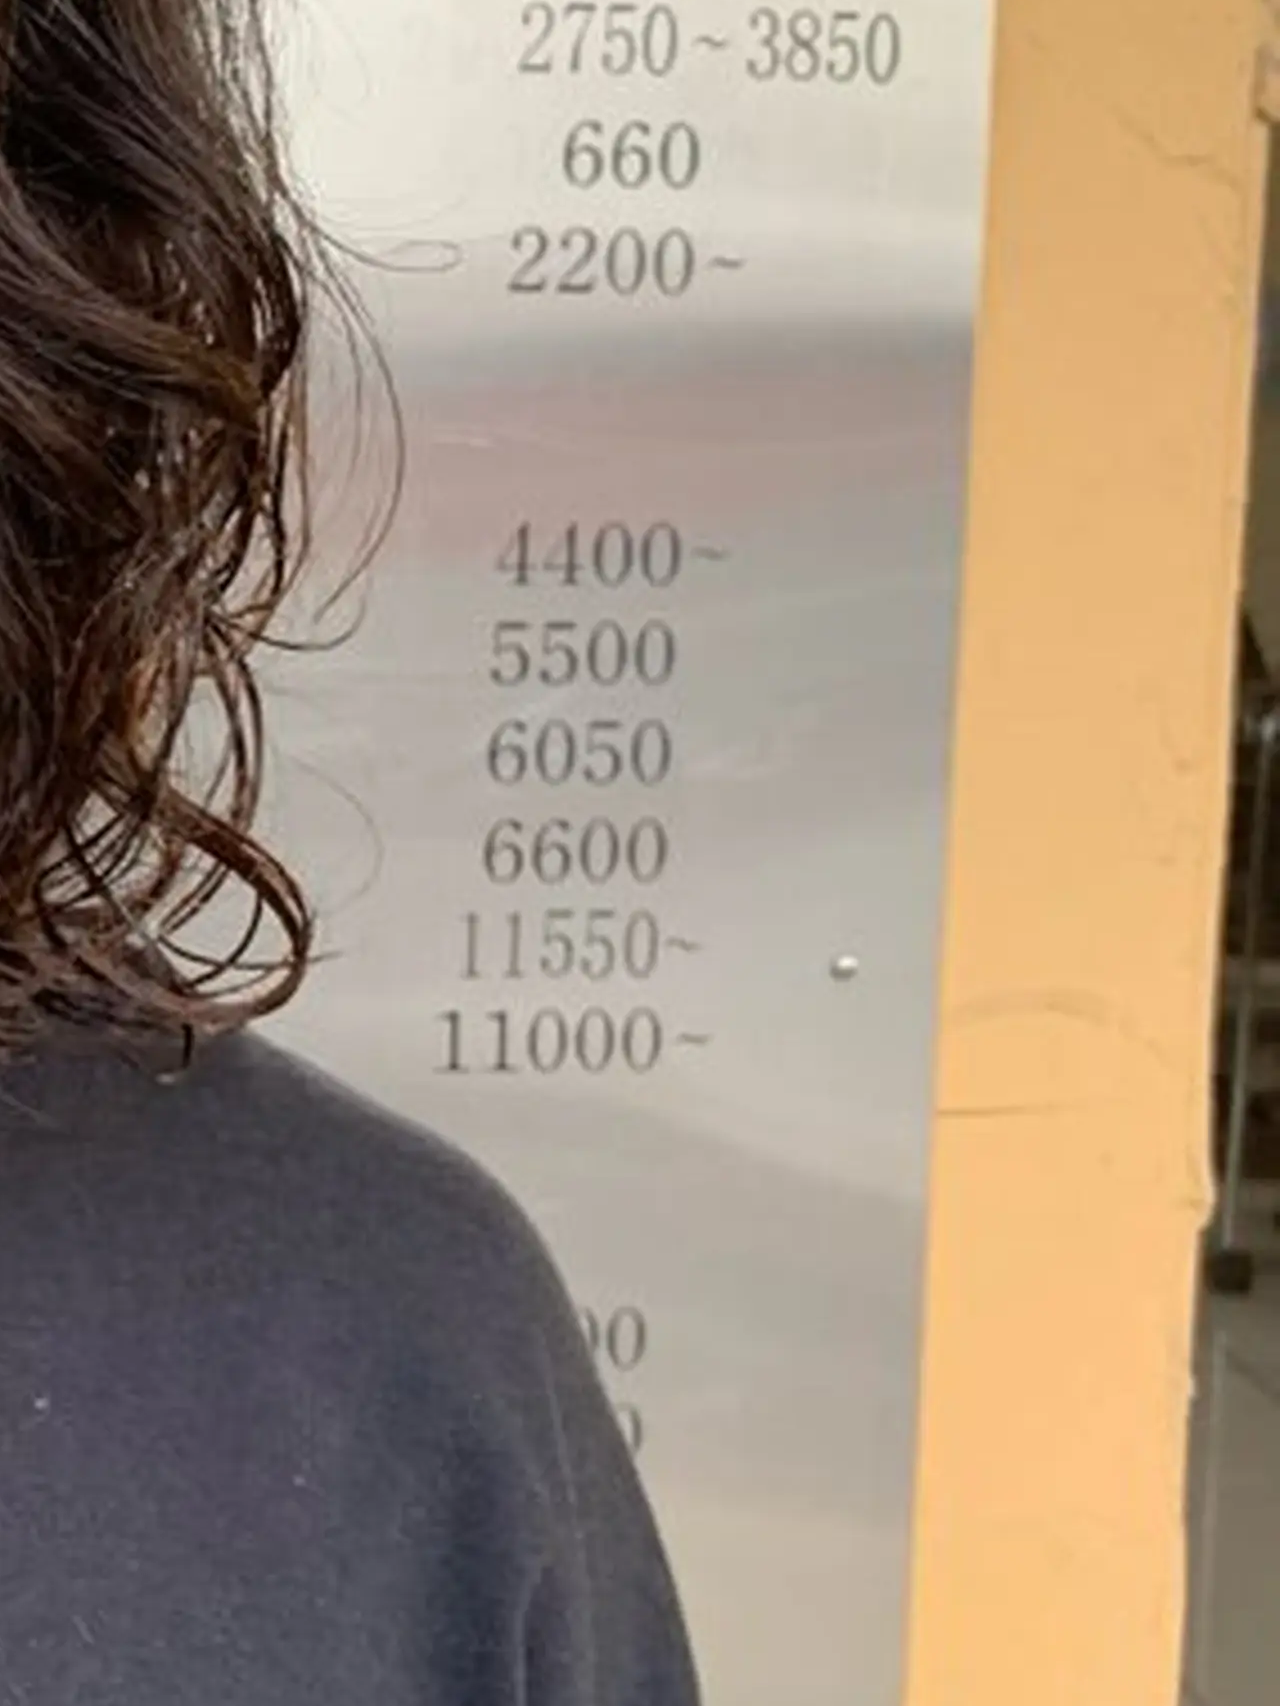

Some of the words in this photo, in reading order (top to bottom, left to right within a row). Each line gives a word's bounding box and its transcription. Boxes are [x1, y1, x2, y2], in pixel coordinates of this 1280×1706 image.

[562, 118, 702, 191] 660
[506, 225, 747, 297] 2200~
[494, 519, 732, 588] 4400~
[488, 618, 676, 687] 5500
[485, 718, 673, 786] 6050
[481, 816, 669, 885] 6600
[458, 907, 703, 981] 11550~
[433, 1005, 715, 1075] 11000~
